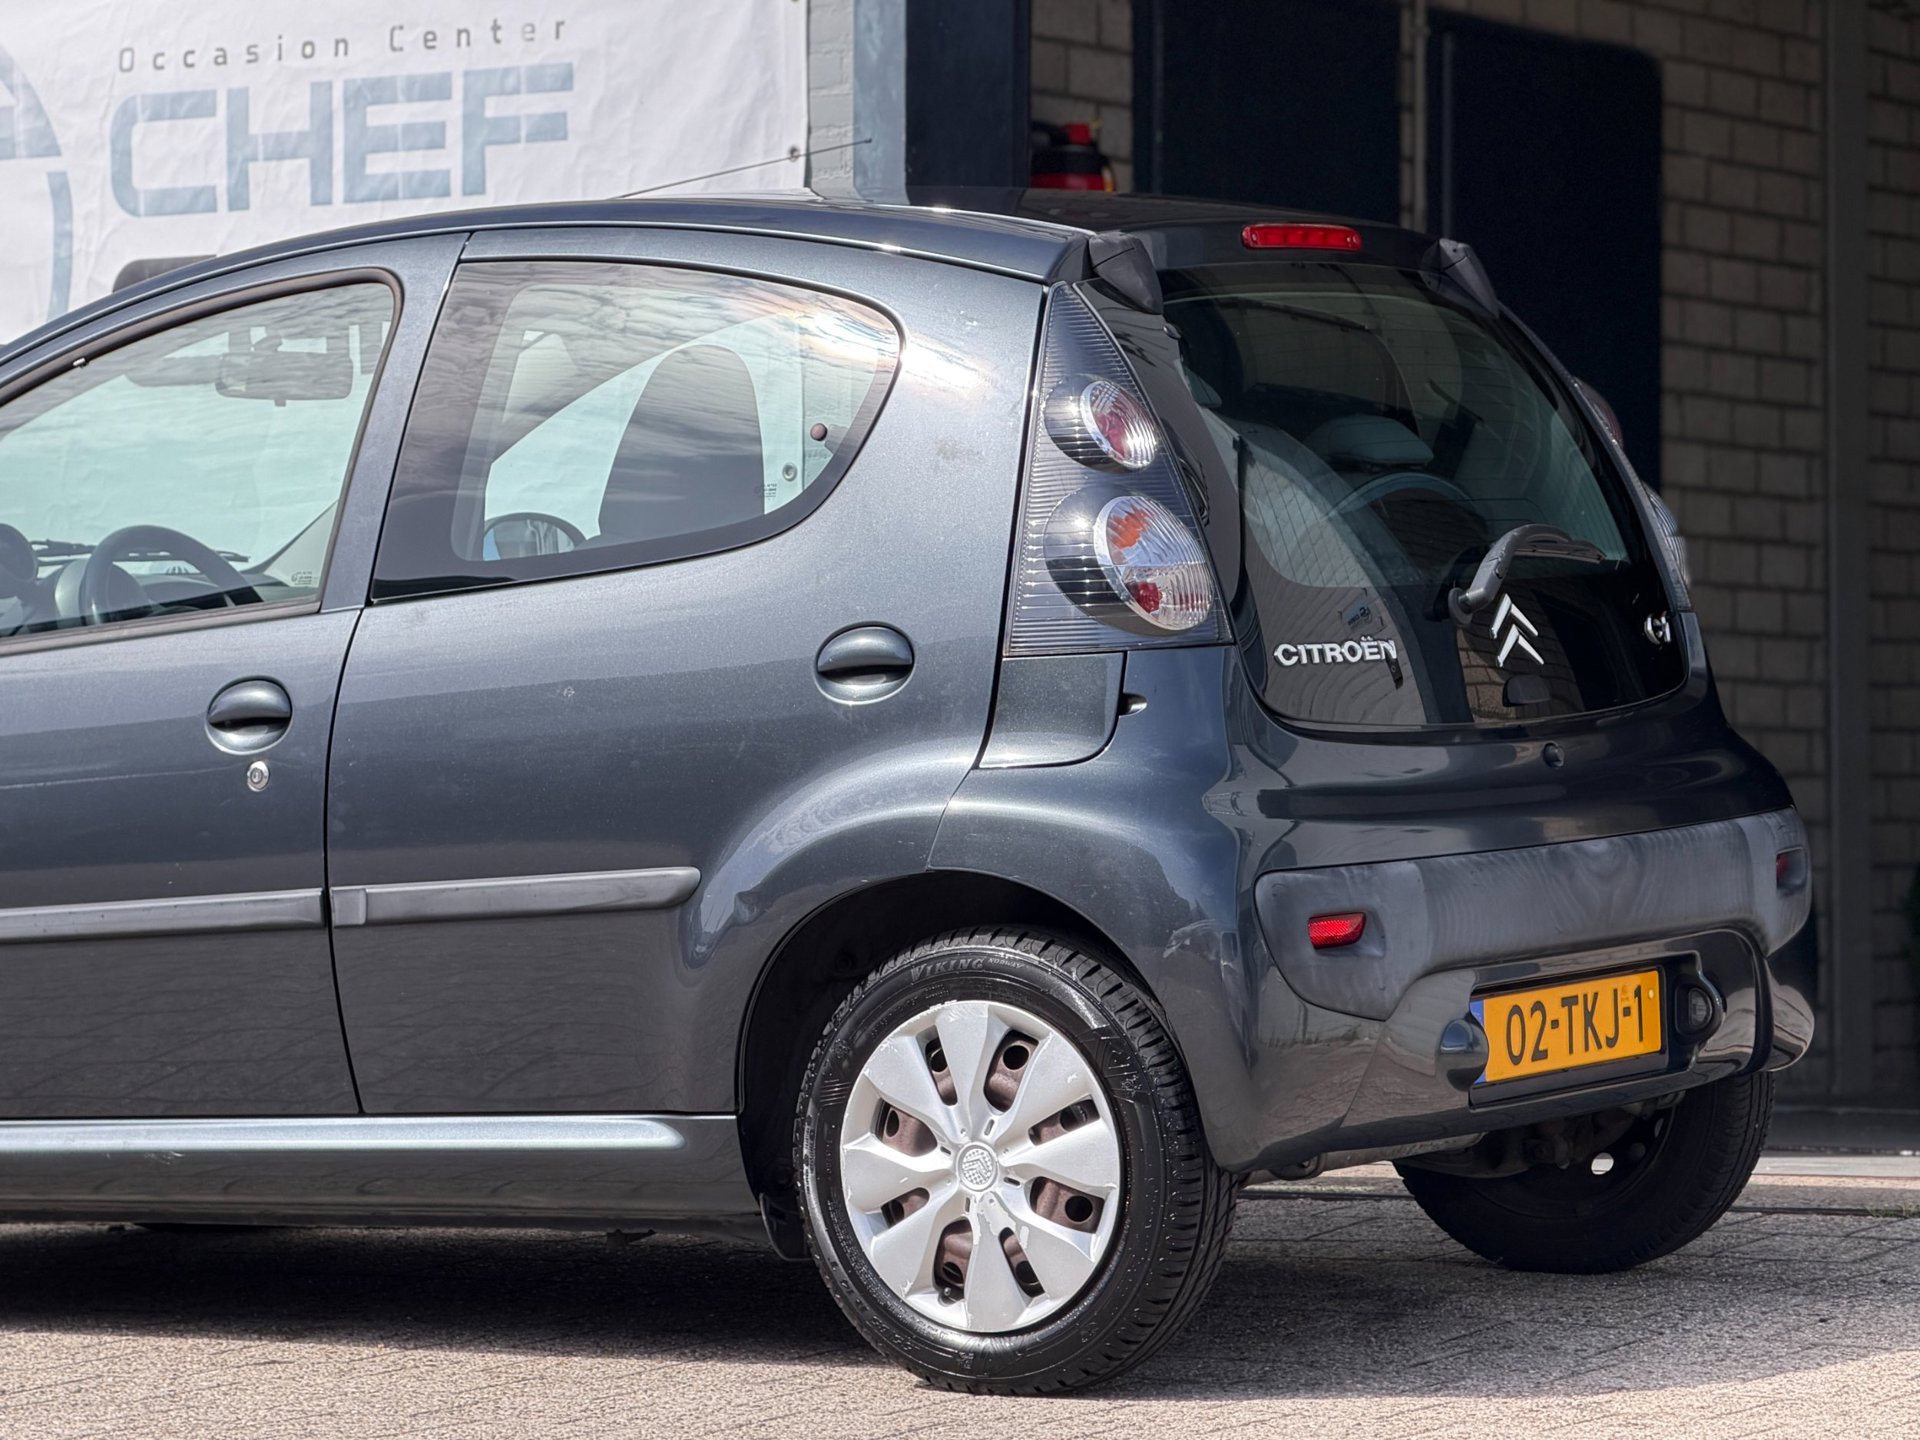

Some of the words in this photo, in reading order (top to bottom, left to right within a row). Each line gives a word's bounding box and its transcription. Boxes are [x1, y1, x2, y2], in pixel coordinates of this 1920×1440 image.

[119, 34, 349, 73] Occasion
[389, 19, 566, 53] Center
[110, 62, 573, 218] CHEF
[1274, 635, 1398, 666] CITROËN
[910, 958, 984, 981] VIKING
[1506, 985, 1643, 1066] 02-TKJ-1
